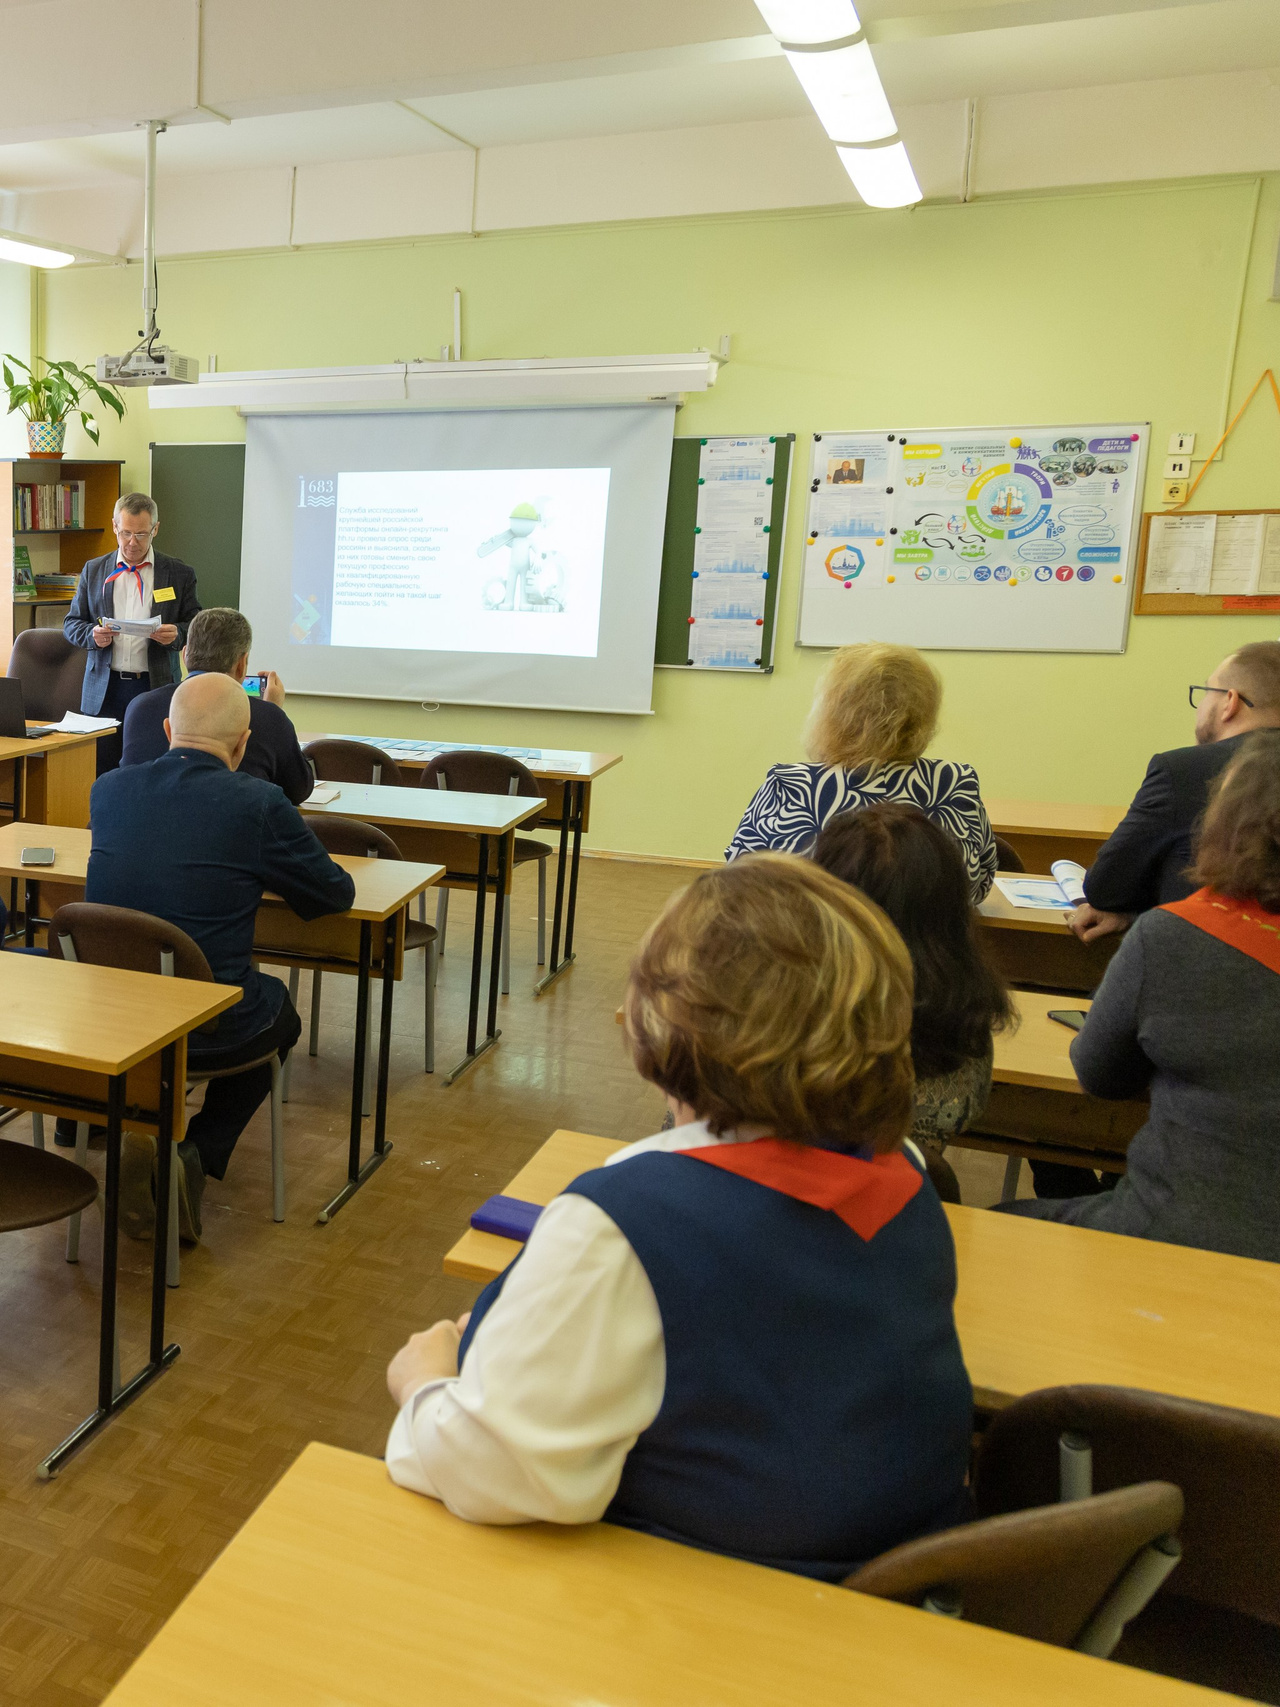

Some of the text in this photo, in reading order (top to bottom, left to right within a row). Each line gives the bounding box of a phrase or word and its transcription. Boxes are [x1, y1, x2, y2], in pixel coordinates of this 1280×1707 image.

[1030, 471, 1046, 486] ТВОРИ
[339, 506, 418, 515] Служба исследований
[338, 516, 424, 524] крупнейшей российской
[338, 526, 449, 534] платформы онлайн-рекрутинга
[368, 563, 410, 571] профессию
[346, 573, 420, 581] квалифицированную
[335, 581, 366, 589] рабочую
